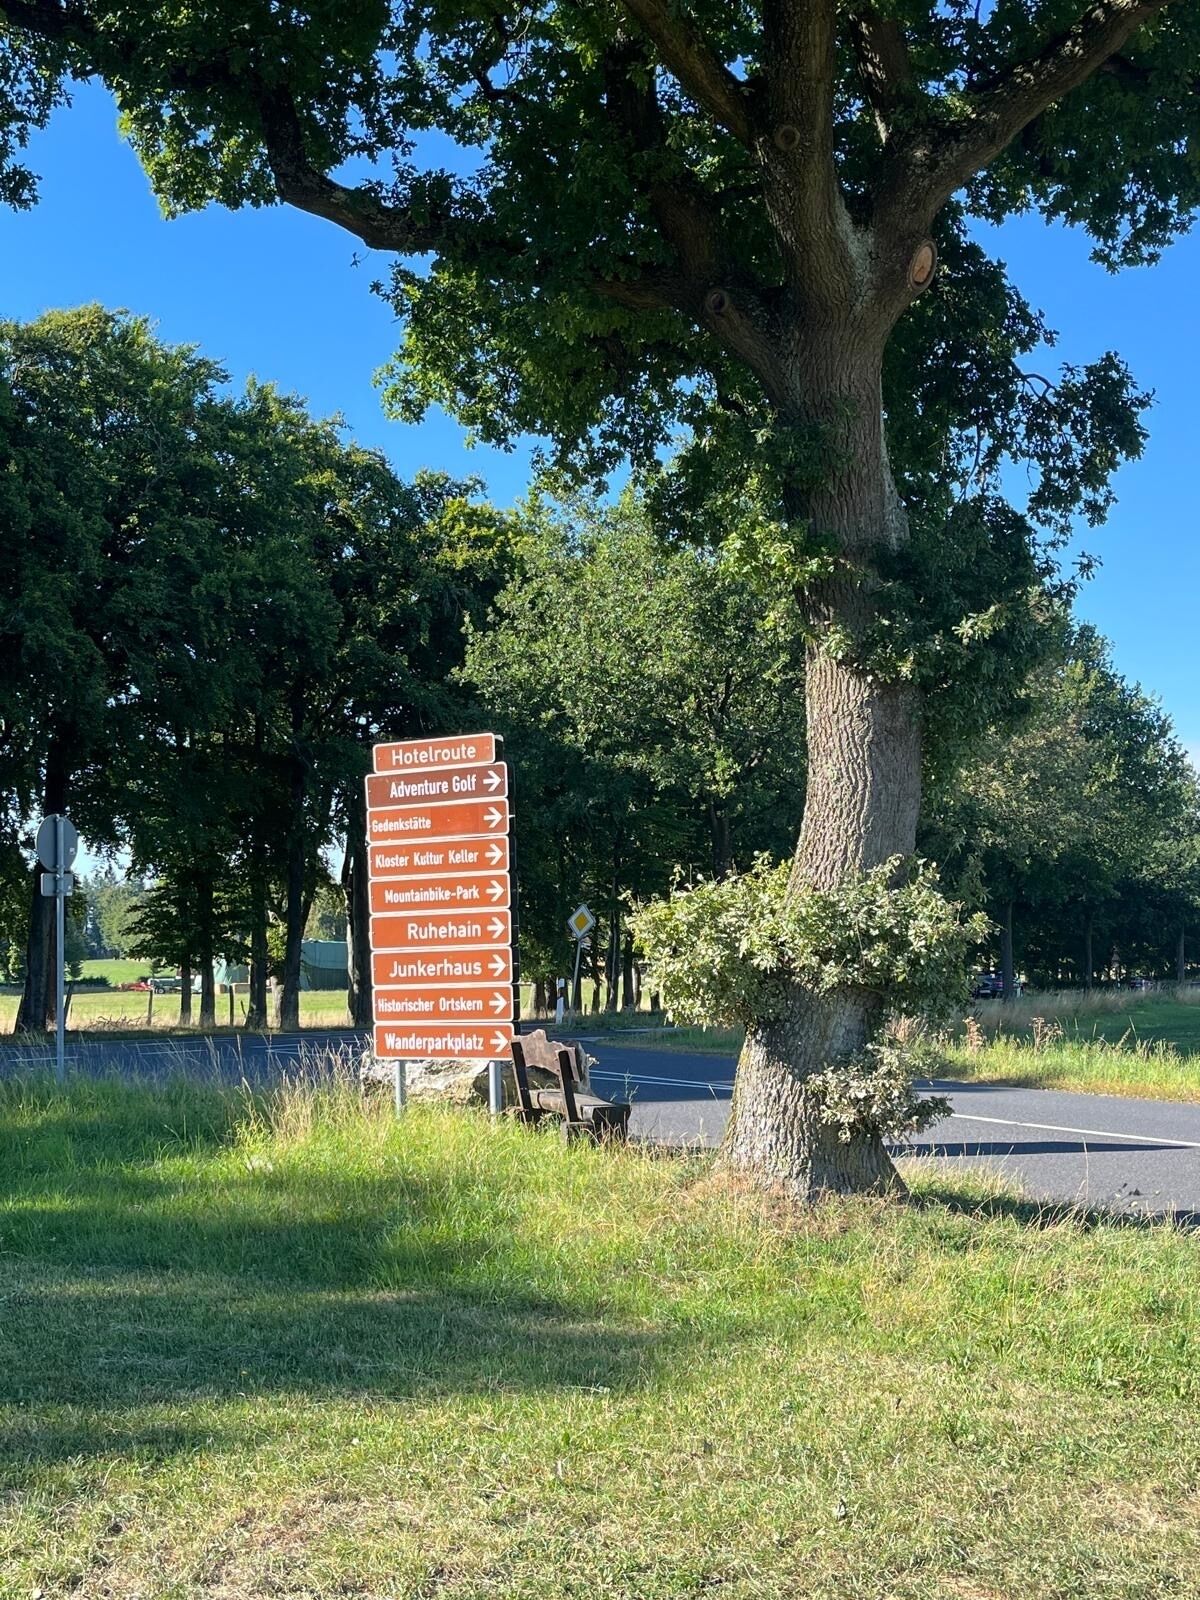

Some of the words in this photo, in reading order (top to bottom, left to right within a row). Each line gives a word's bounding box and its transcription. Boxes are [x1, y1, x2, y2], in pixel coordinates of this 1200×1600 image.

[391, 744, 476, 766] Hotelroute
[390, 780, 449, 798] Adventure
[452, 775, 477, 792] Golf
[372, 817, 431, 833] Gedenkstätte
[375, 854, 409, 868] Kloster
[413, 852, 444, 866] Kultur
[448, 850, 479, 864] Keller
[384, 886, 480, 904] Mountainbike-Park
[407, 921, 481, 939] Ruhehain
[389, 959, 482, 978] Junkerhaus
[378, 998, 435, 1012] Historischer
[439, 997, 483, 1012] Ortskern
[385, 1033, 484, 1054] Wanderparkplatz
